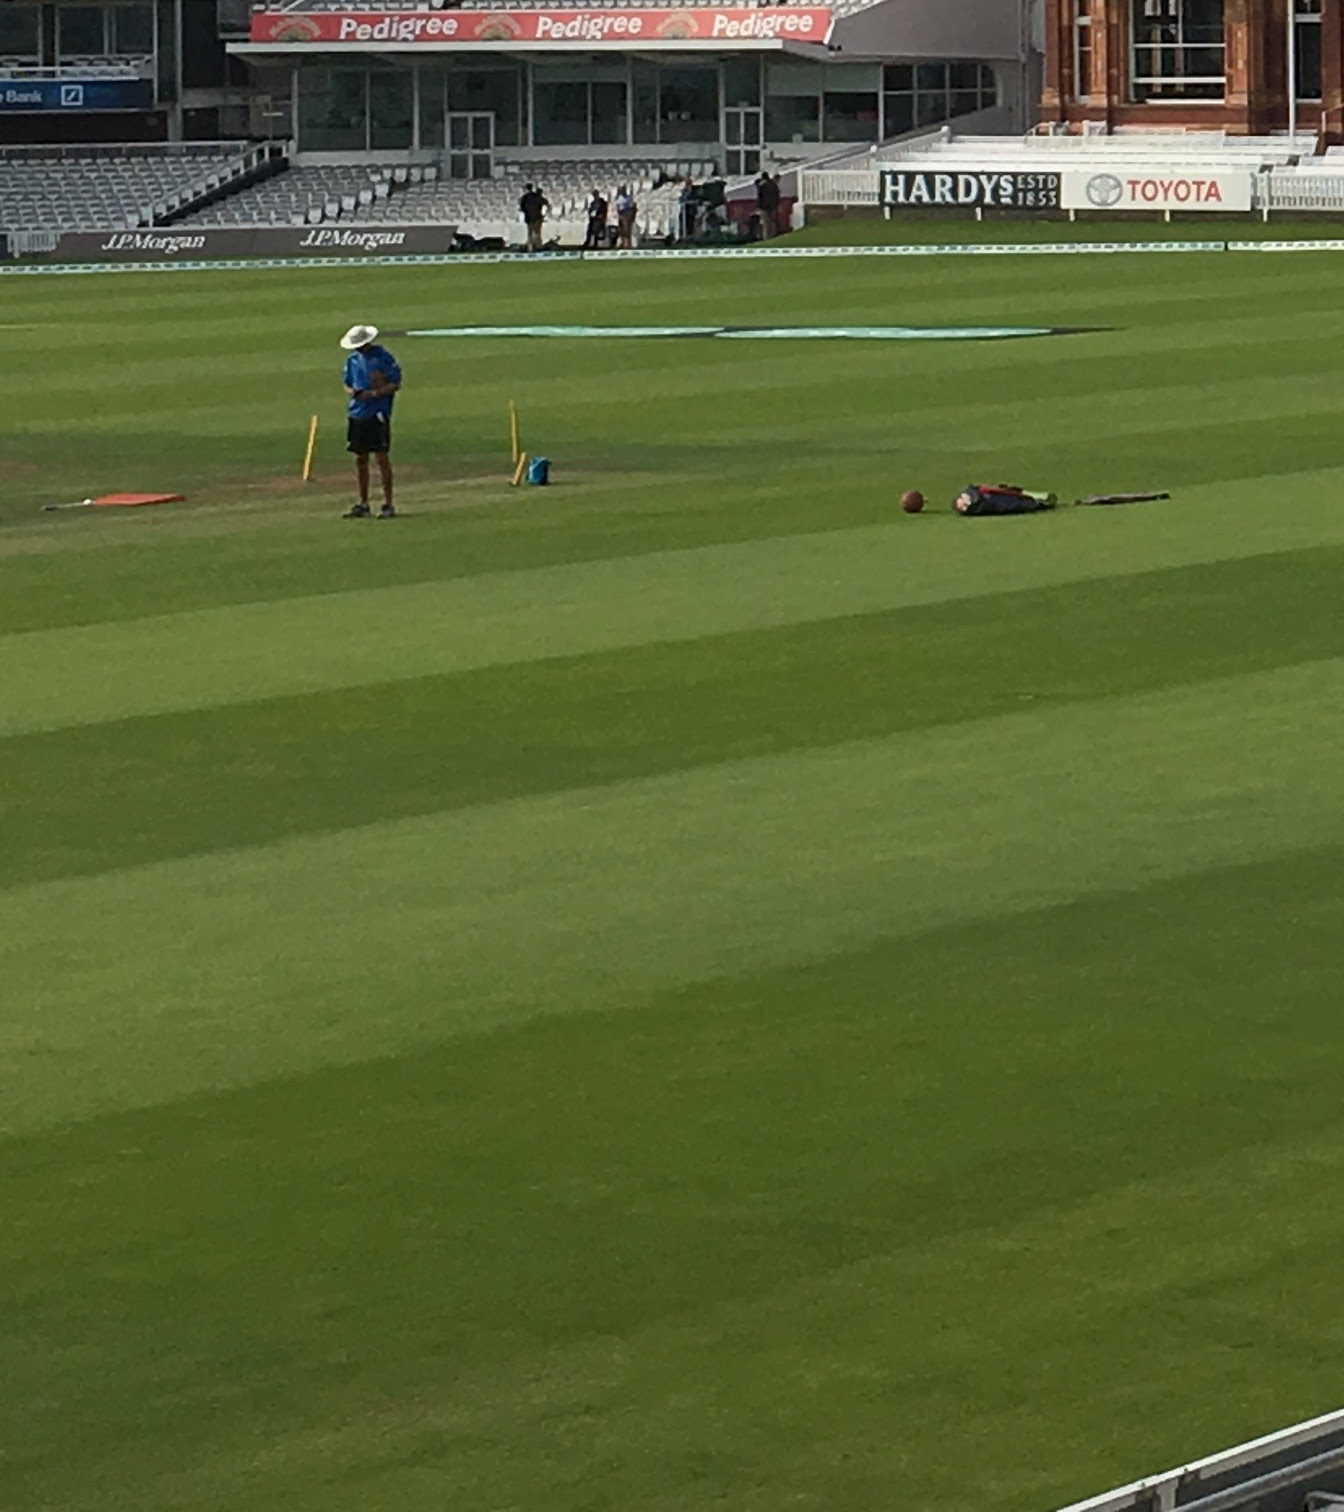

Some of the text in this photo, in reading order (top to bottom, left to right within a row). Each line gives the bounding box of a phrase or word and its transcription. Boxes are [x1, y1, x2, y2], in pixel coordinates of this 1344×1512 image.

[339, 17, 458, 41] Pedigree
[536, 16, 643, 39] Pedigree
[712, 14, 813, 37] Pedigree
[6, 90, 42, 103] Bank
[1018, 175, 1058, 188] ESTD
[1127, 180, 1222, 202] TOYOTA
[1018, 190, 1057, 206] 1853
